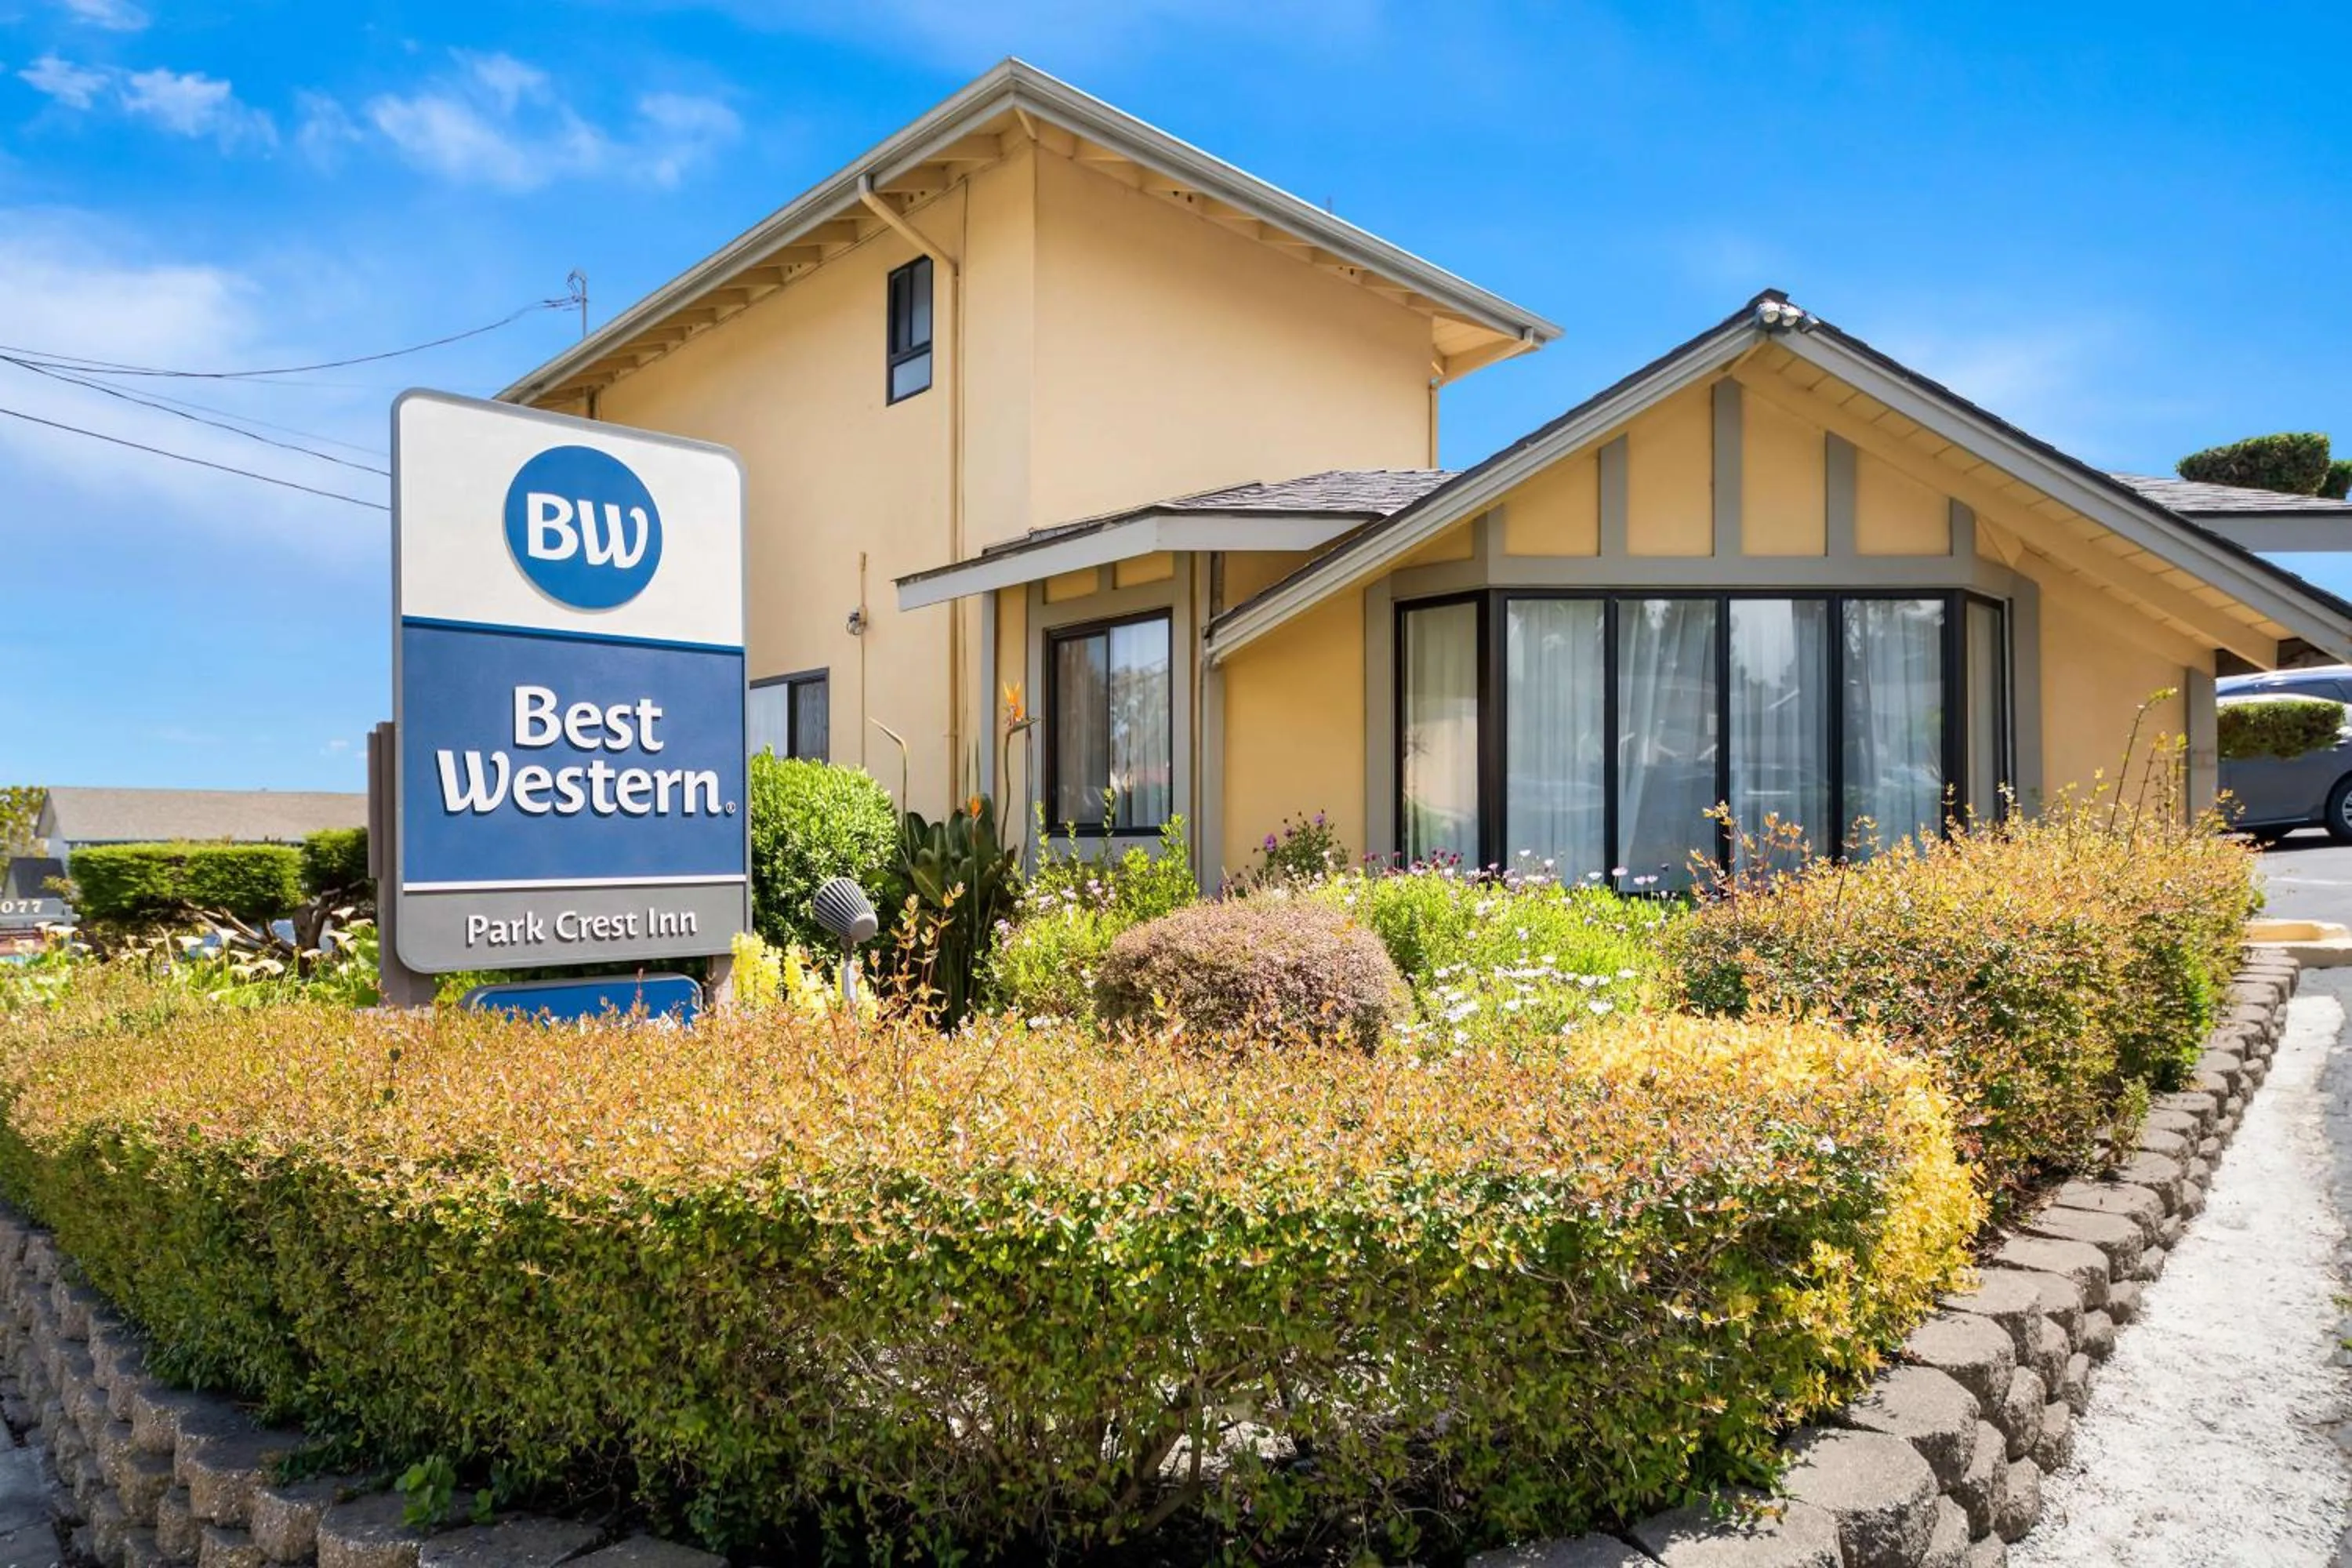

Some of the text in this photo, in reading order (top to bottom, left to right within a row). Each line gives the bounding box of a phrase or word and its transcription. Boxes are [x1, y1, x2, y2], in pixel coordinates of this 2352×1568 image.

[526, 492, 649, 569] BW
[514, 685, 664, 752] Best
[436, 750, 722, 814] Western
[1, 900, 43, 914] 077
[468, 907, 698, 944] Park Crest Inn
